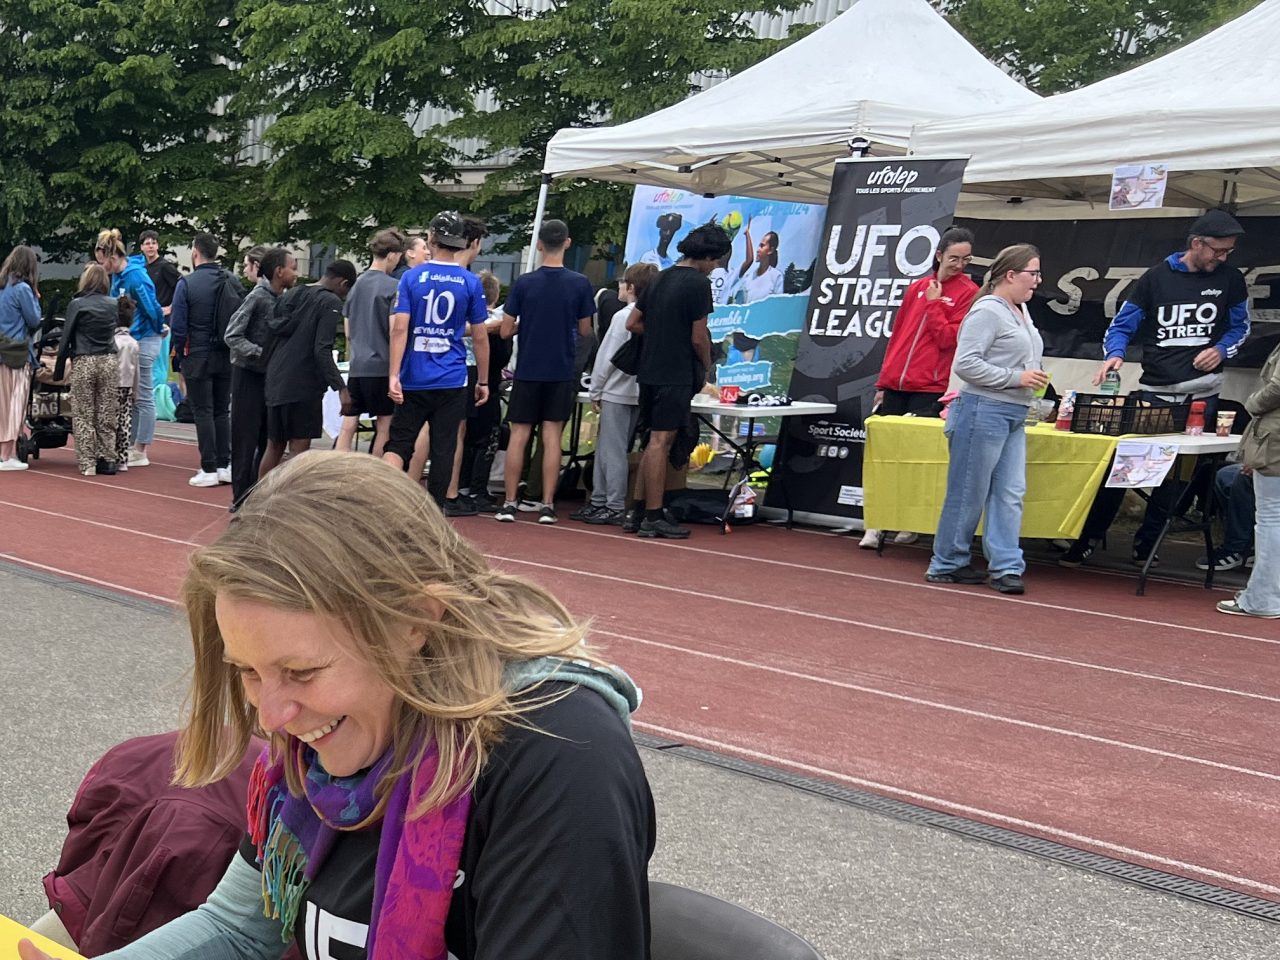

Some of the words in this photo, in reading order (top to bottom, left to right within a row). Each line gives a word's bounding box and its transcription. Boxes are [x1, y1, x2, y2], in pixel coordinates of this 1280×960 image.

[867, 166, 919, 192] ufolep
[826, 224, 941, 277] UFO
[817, 277, 920, 306] STREE
[422, 288, 455, 325] 10
[1157, 302, 1218, 327] UFO
[809, 308, 895, 338] LEAGU
[1156, 323, 1216, 339] STREET
[808, 424, 833, 436] Sport
